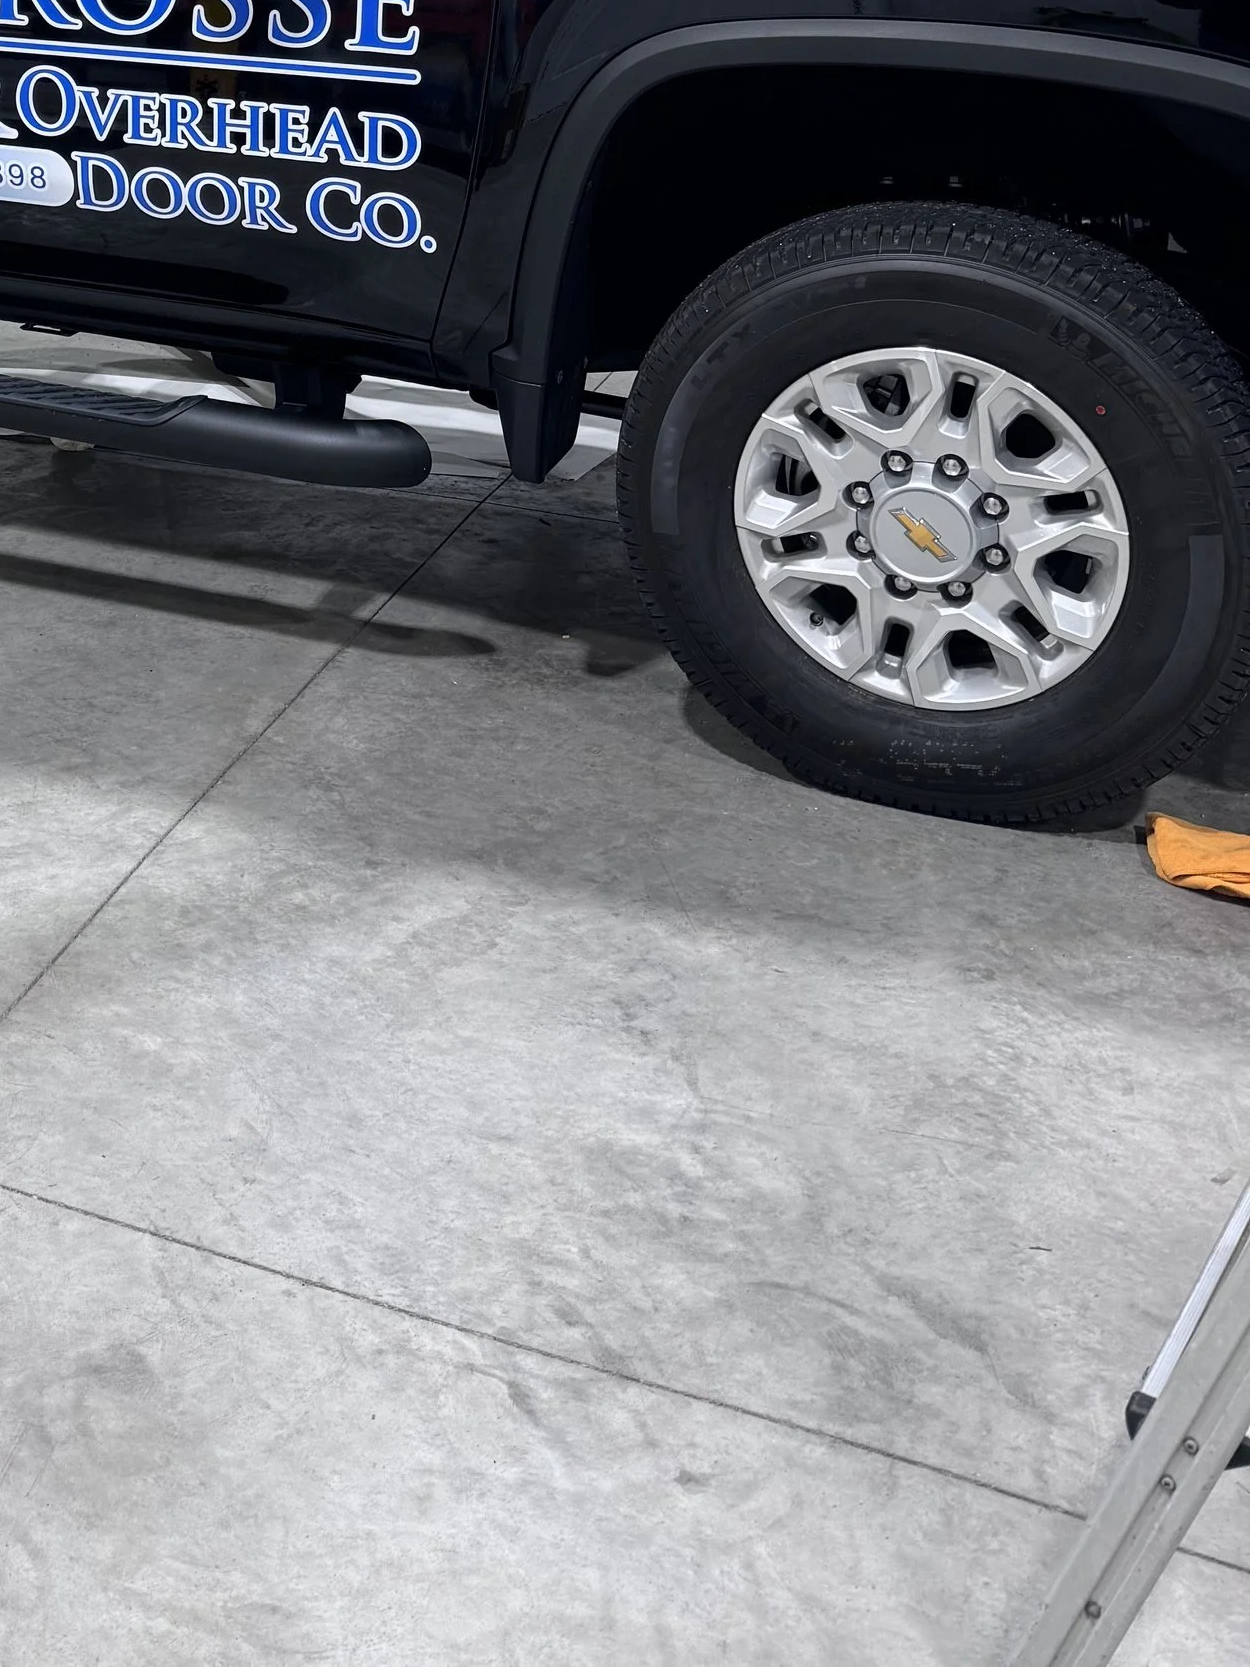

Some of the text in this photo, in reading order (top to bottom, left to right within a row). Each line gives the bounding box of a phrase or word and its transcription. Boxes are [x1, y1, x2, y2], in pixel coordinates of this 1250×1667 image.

[15, 64, 422, 171] OVERHEAD
[71, 150, 437, 254] DOOR CO.
